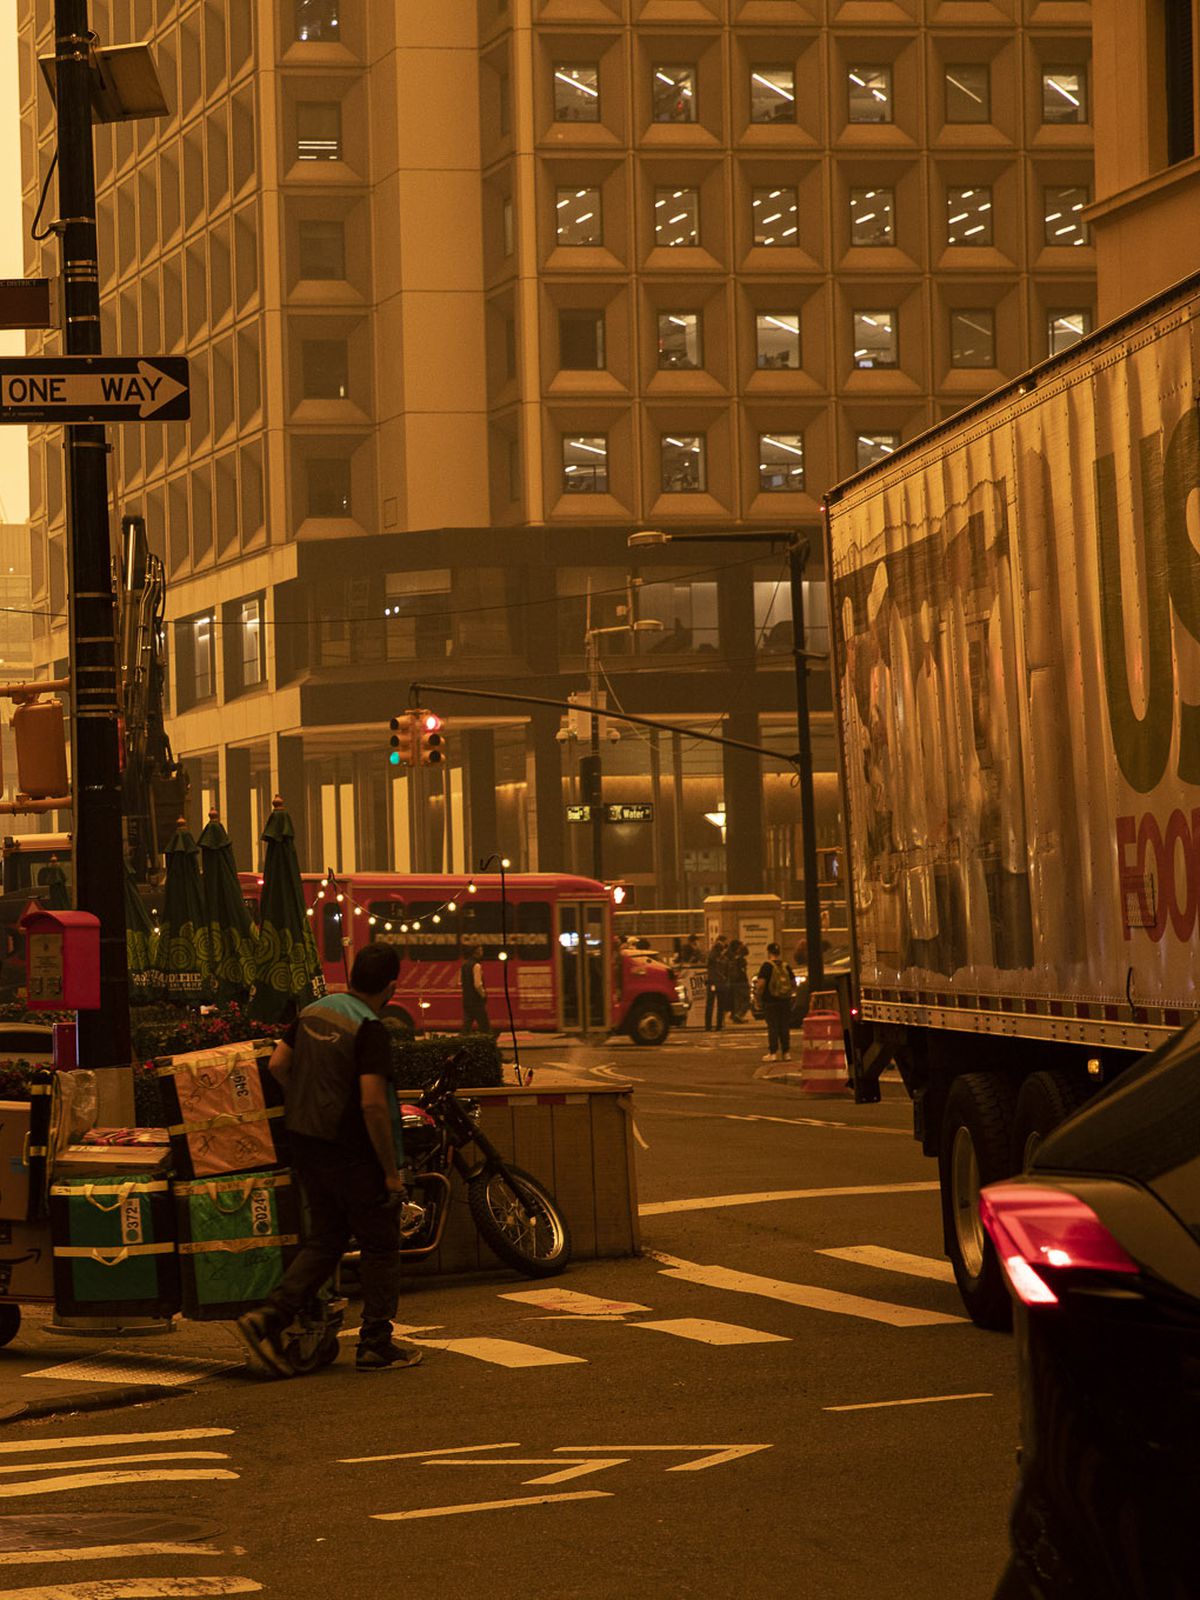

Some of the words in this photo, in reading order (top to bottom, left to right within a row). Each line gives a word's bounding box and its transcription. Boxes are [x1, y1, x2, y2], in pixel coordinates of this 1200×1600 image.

[8, 378, 67, 403] ONE
[100, 377, 164, 401] WAY
[622, 807, 644, 820] Water
[375, 933, 457, 945] DOWNTOWN
[461, 933, 548, 945] CONNECTION
[126, 1205, 140, 1229] 372
